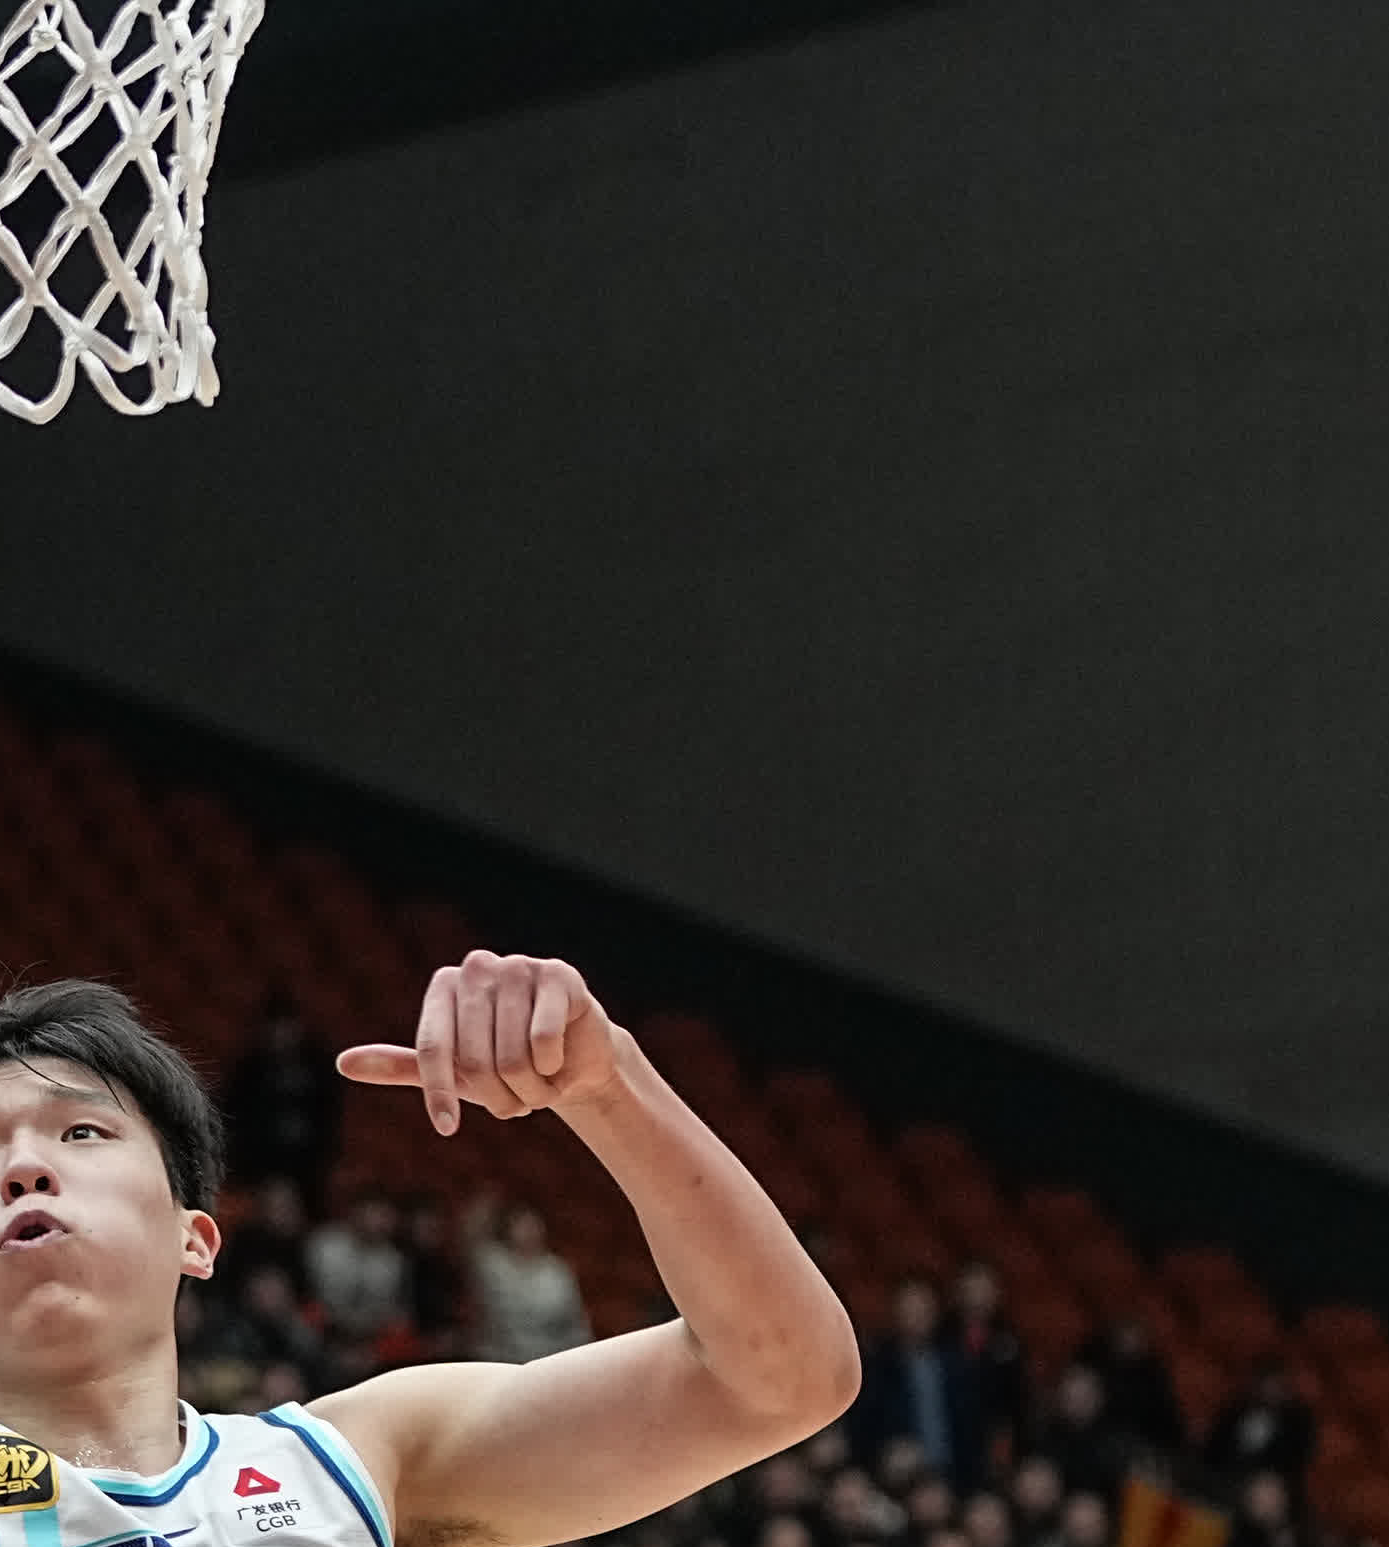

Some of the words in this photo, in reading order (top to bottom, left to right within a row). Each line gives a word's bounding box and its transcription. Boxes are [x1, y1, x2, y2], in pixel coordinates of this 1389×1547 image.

[236, 1498, 302, 1521] 广发银行
[255, 1514, 297, 1533] CGB
